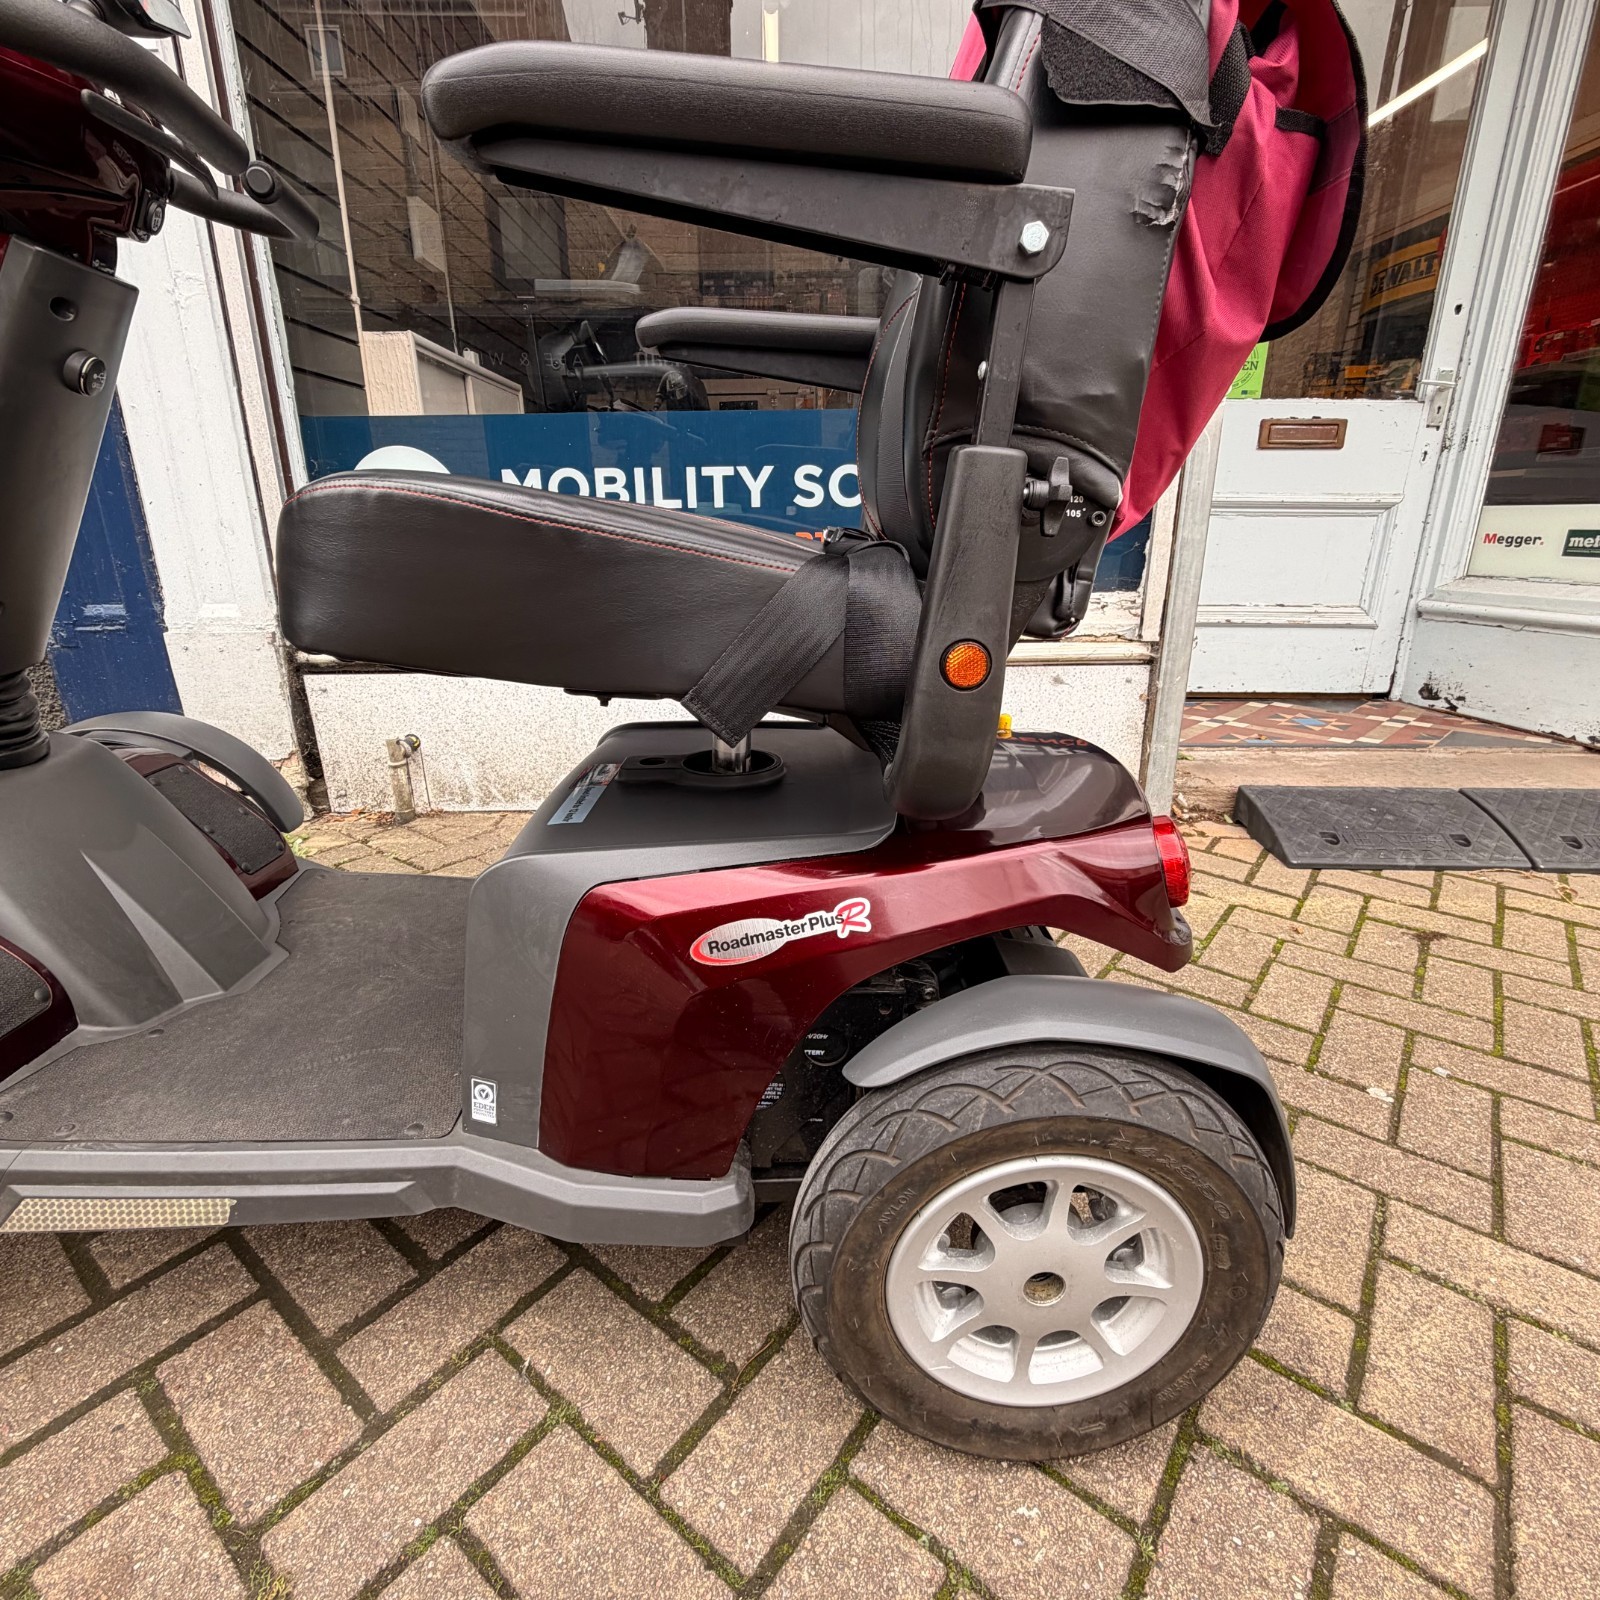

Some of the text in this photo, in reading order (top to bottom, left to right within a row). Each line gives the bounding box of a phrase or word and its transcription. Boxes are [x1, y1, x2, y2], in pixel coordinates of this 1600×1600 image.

[1370, 251, 1438, 298] DEWALT
[1070, 495, 1084, 503] 120
[473, 1101, 496, 1112] EDEN
[878, 1188, 917, 1225] NYLON
